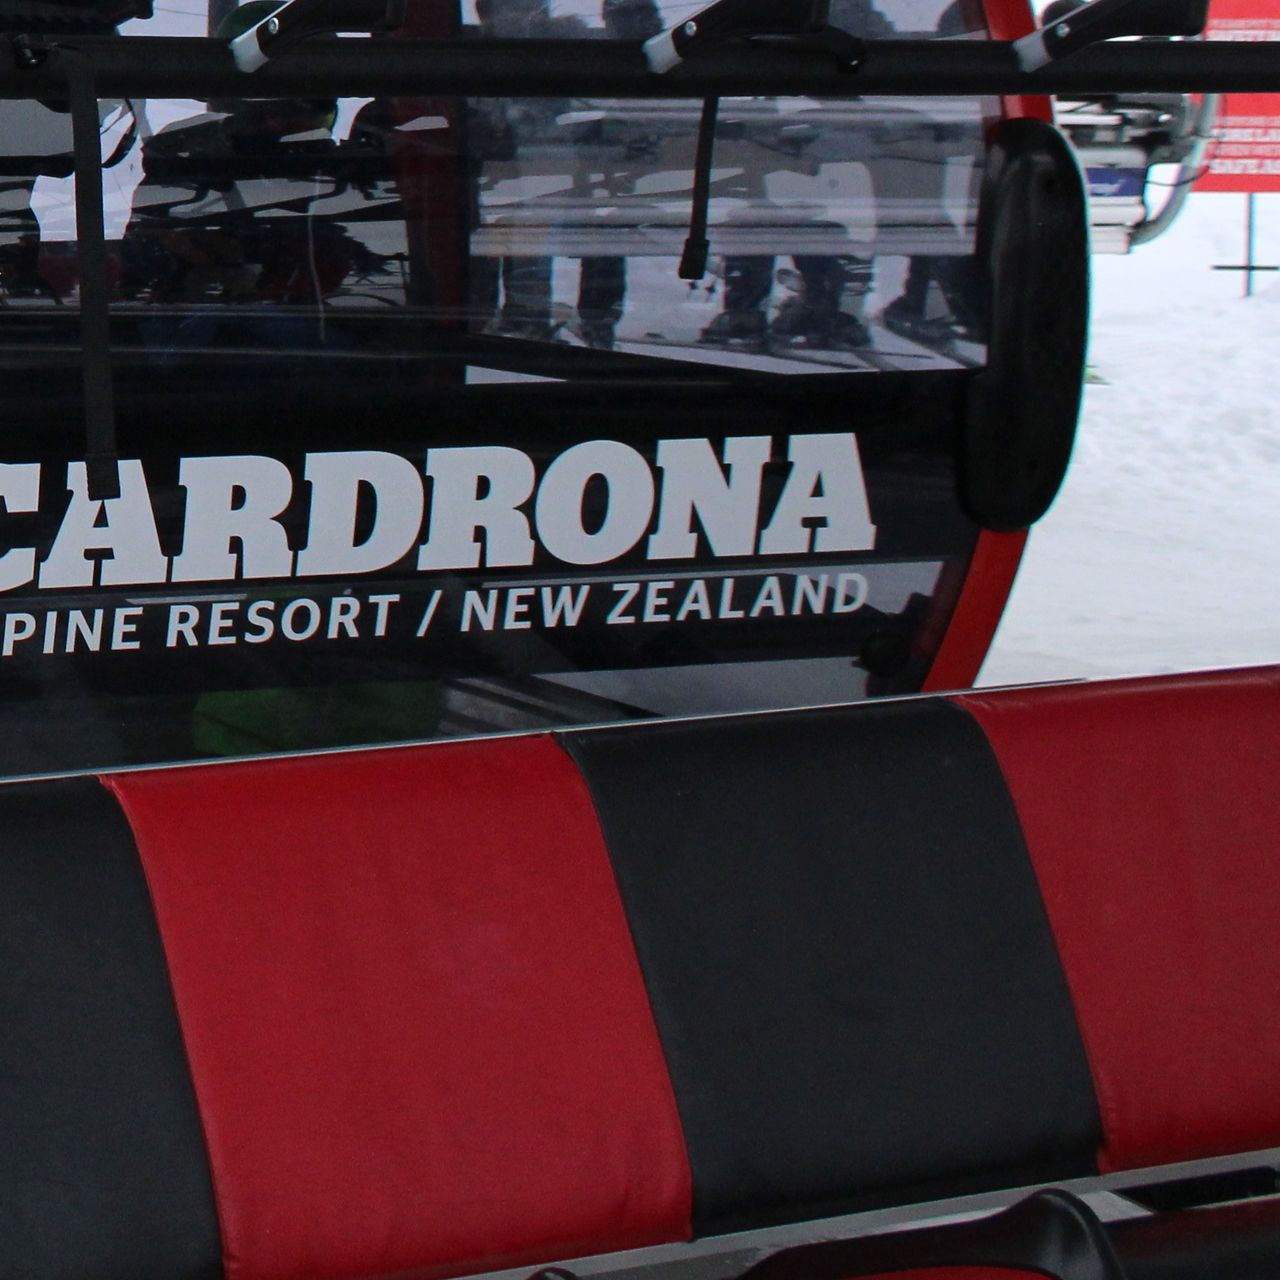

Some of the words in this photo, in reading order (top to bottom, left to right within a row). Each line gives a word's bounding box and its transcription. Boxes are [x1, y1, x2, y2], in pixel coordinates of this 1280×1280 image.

[166, 594, 401, 647] RESORT
[416, 589, 443, 637] /
[460, 584, 591, 632] NEW
[606, 572, 870, 625] ZEALAND
